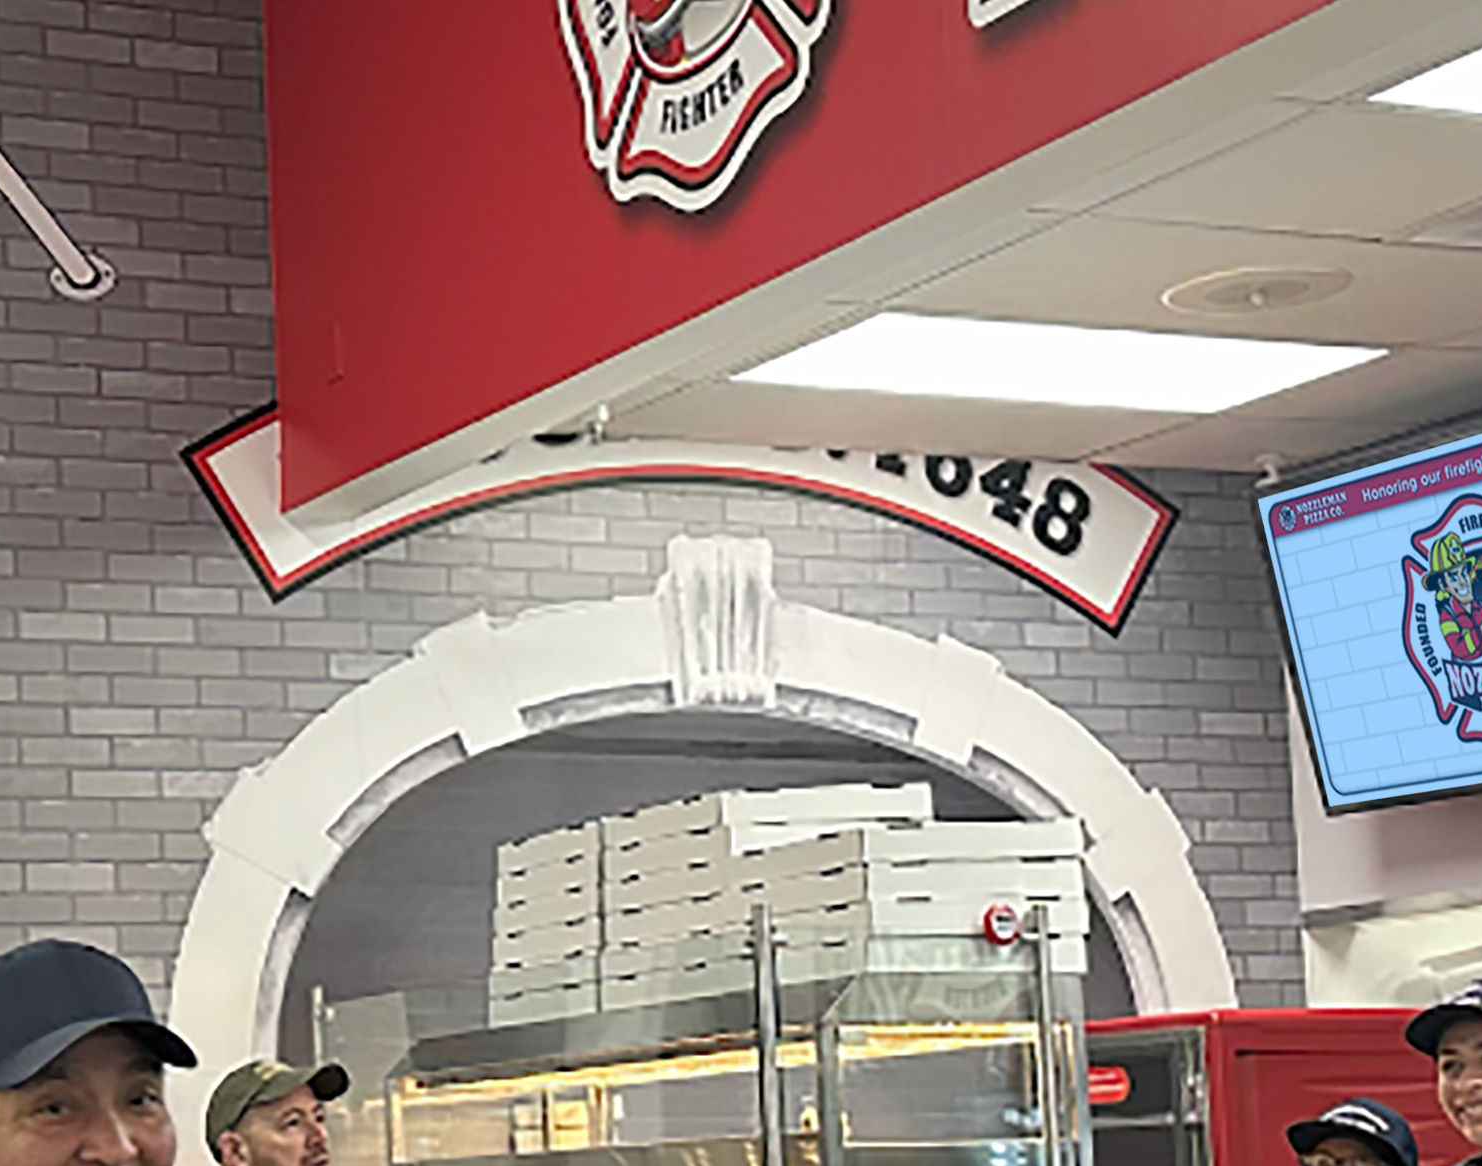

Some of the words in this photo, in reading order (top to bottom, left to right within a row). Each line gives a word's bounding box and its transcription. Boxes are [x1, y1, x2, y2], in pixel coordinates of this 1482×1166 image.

[660, 59, 745, 134] FIGHTER
[875, 454, 1091, 556] 648
[1296, 490, 1347, 516] NOZZLEMAN
[1361, 477, 1418, 503] Honoring
[1420, 469, 1443, 486] our
[1415, 602, 1442, 677] FOUNDED
